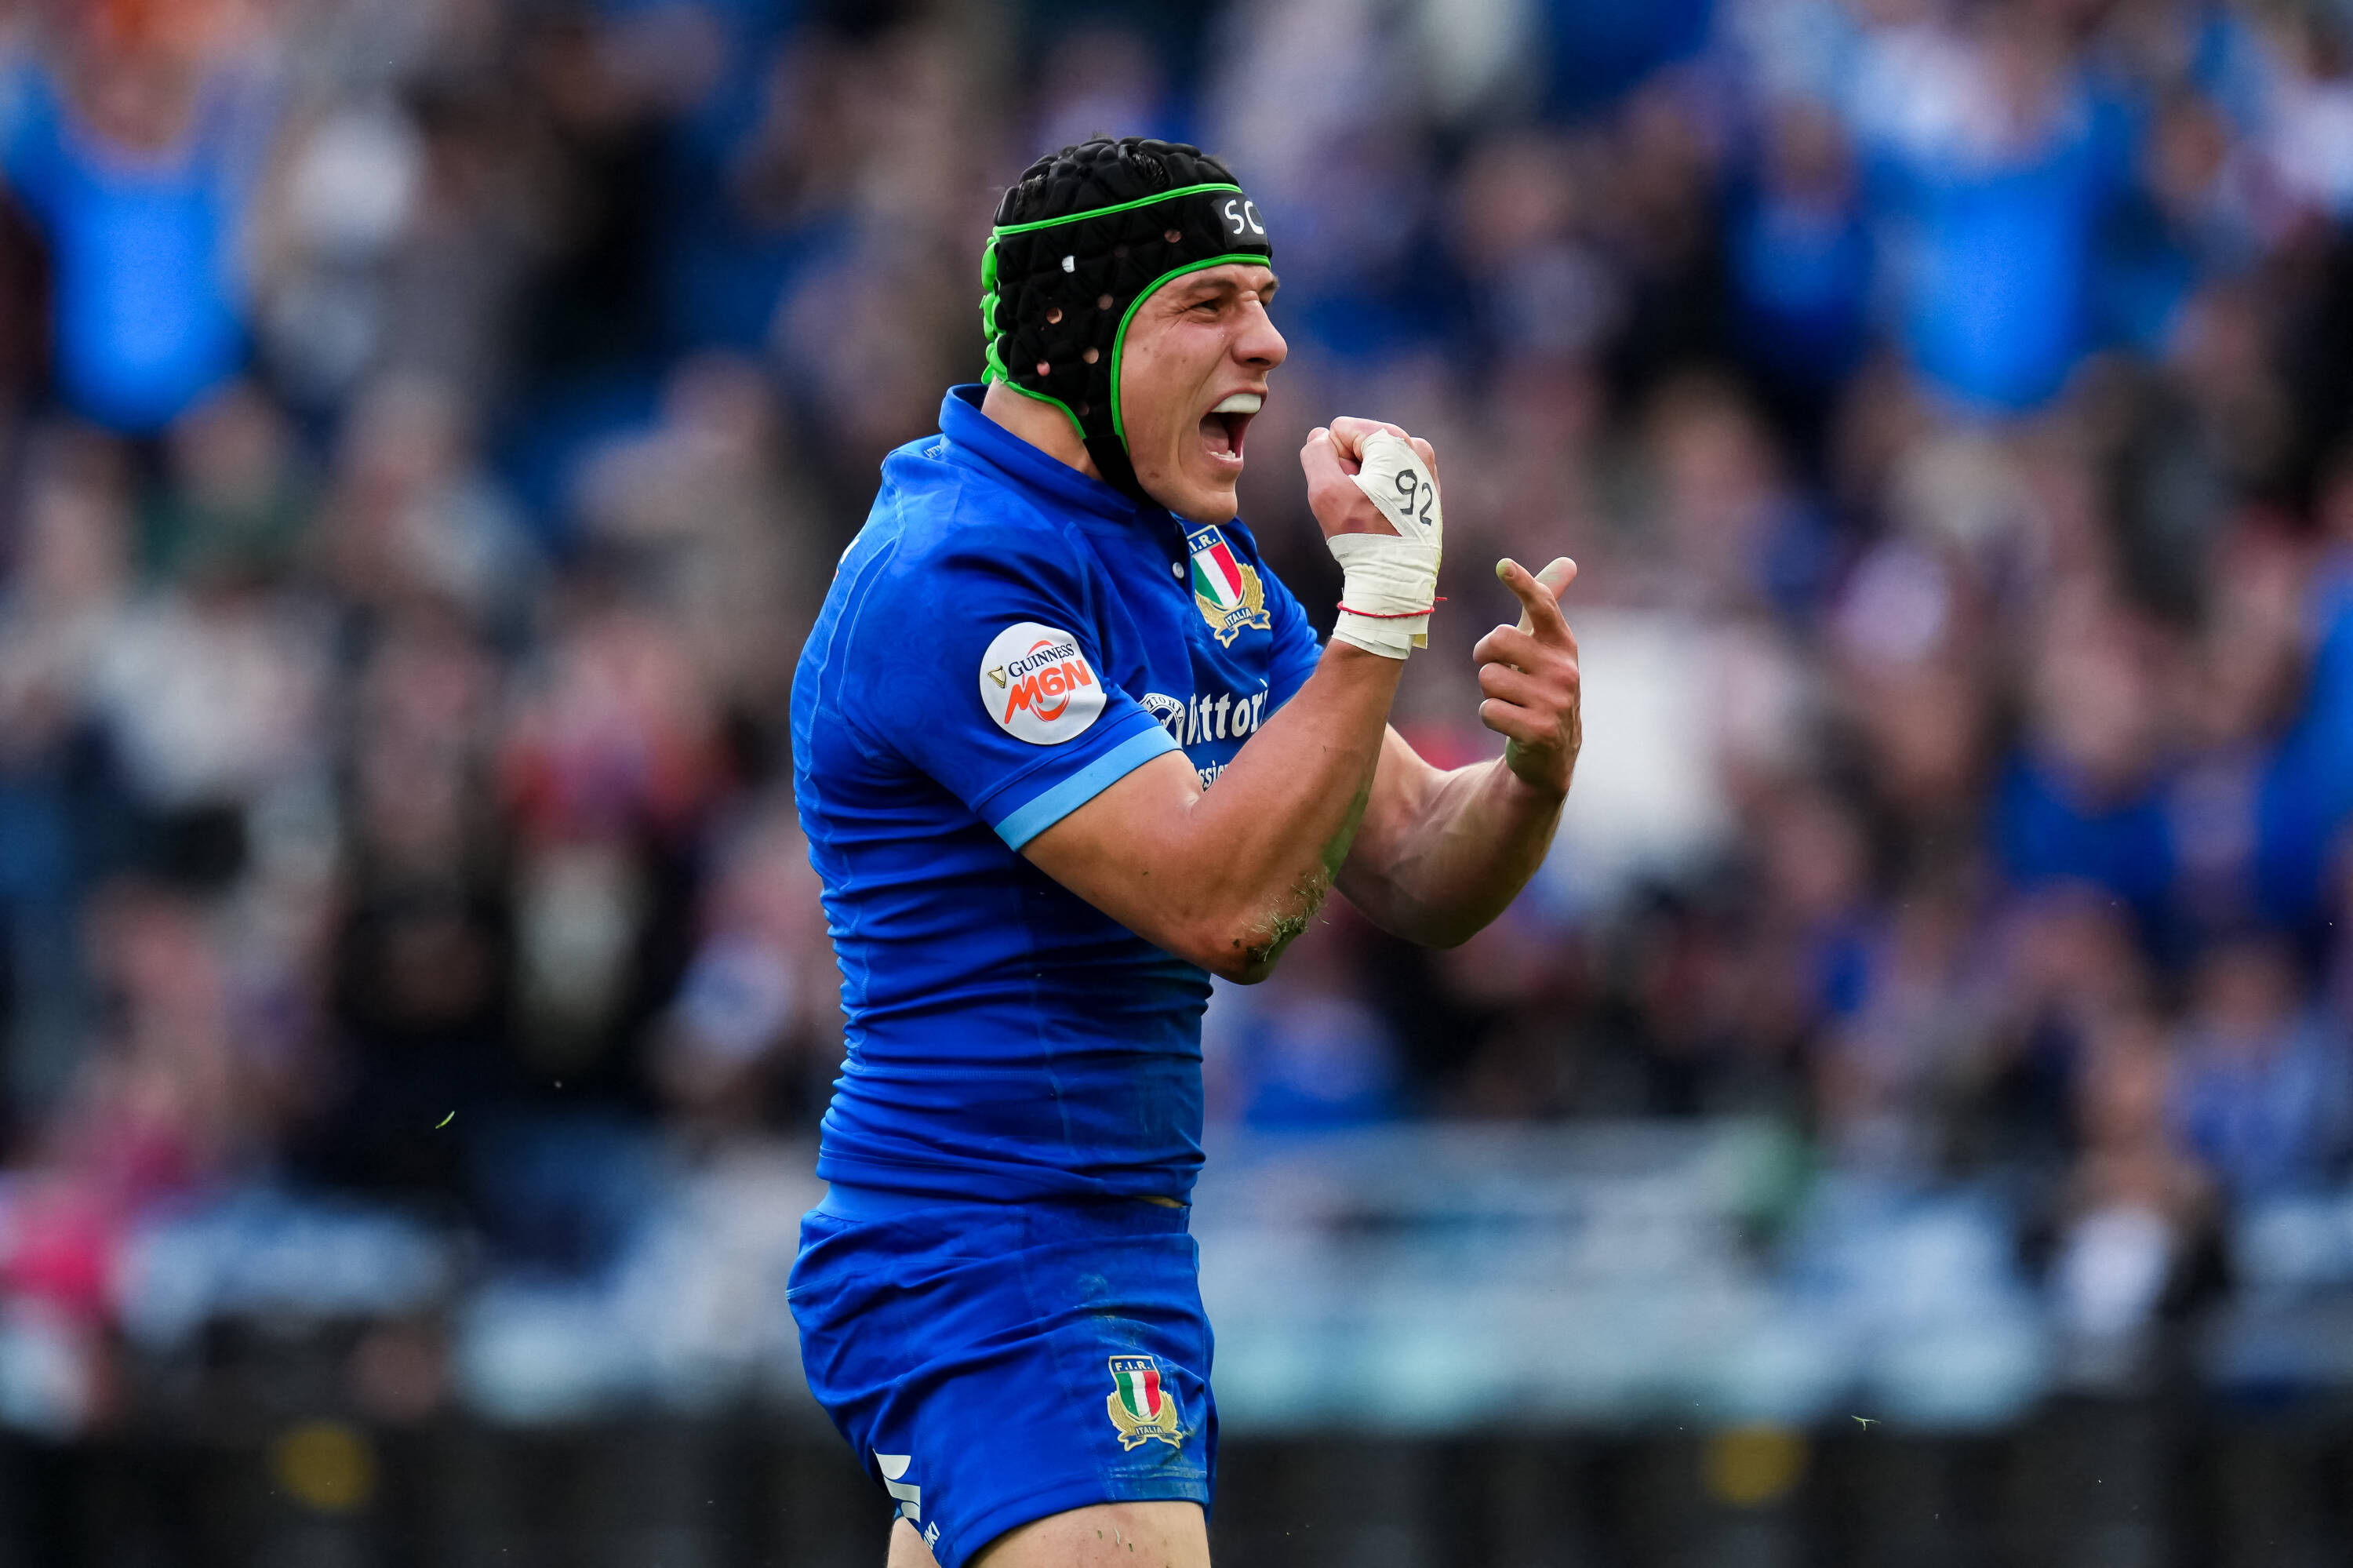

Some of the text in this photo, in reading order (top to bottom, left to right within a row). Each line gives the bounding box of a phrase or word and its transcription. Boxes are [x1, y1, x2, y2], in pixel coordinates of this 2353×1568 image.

[1395, 468, 1433, 526] 92
[1224, 608, 1253, 627] ITALIA
[1008, 643, 1075, 678] GUINNESS
[1004, 659, 1093, 725] M6N
[1146, 696, 1184, 724] TTORIA
[1115, 1360, 1151, 1371] F.I.R.
[1135, 1426, 1164, 1436] ITALIA
[923, 1520, 940, 1551] UKI
